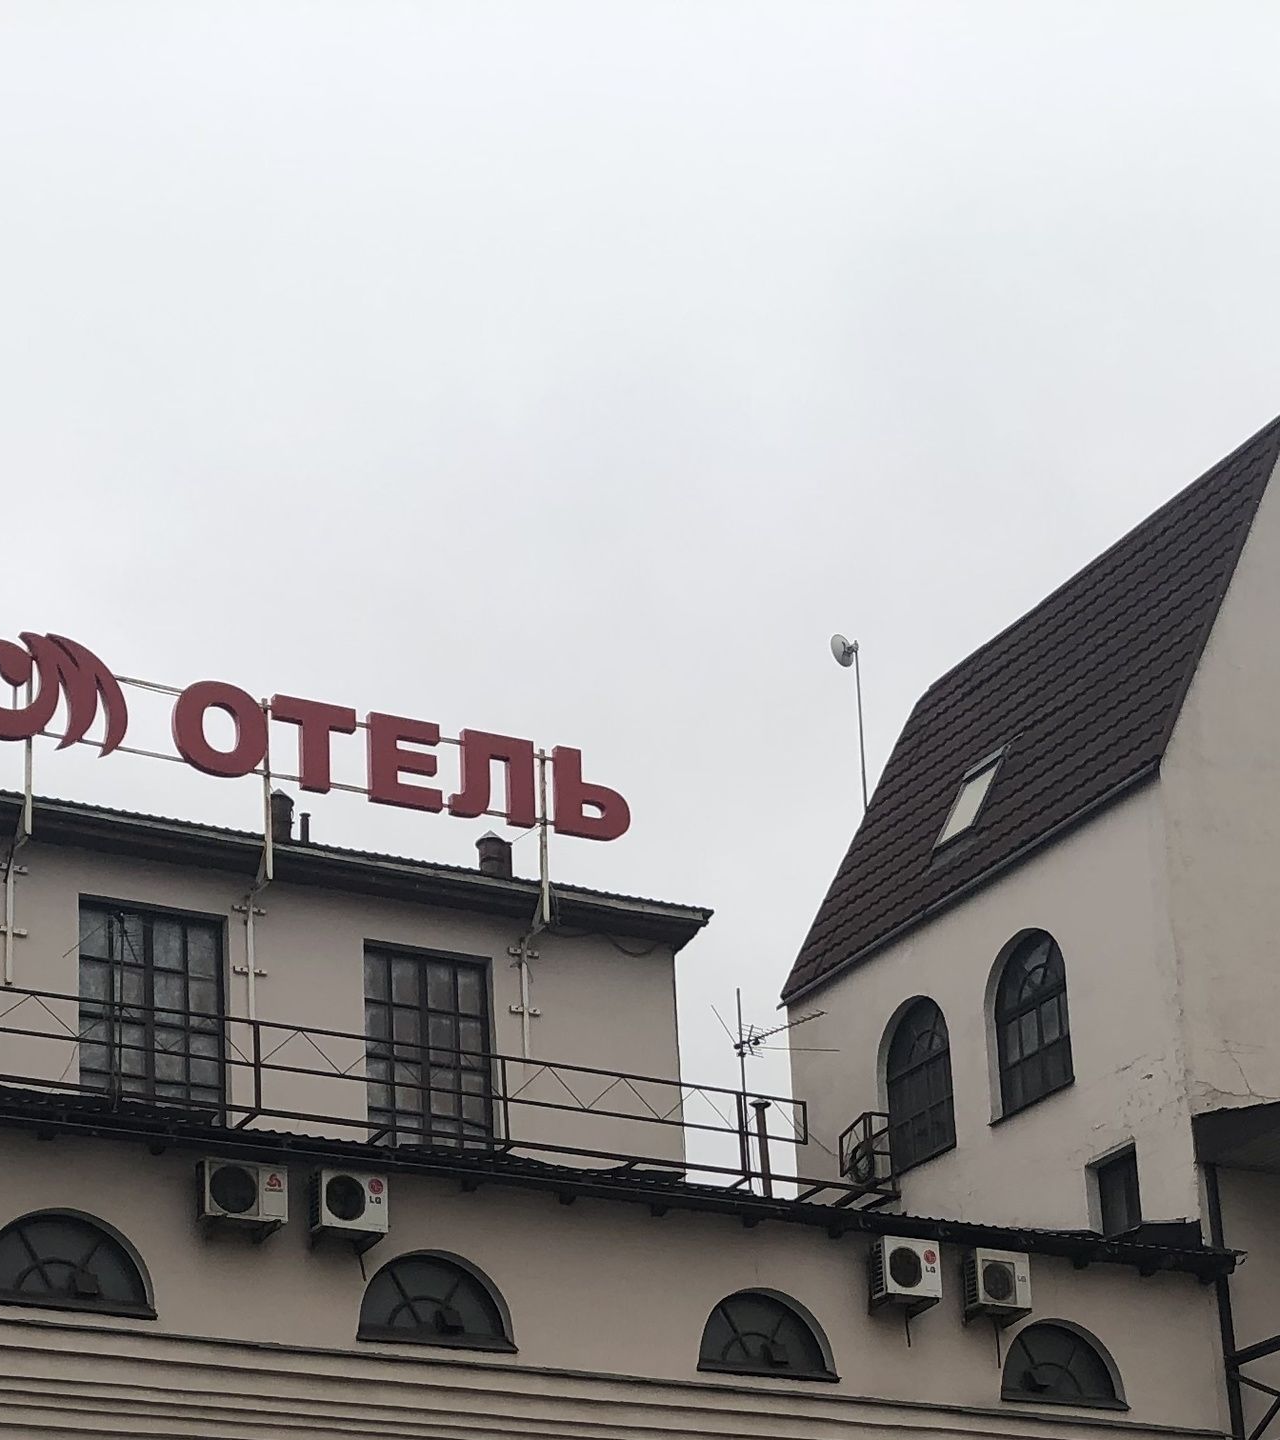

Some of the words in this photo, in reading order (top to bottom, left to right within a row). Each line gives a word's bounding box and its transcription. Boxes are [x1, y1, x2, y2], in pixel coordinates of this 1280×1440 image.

[172, 679, 631, 842] ОТЕЛЬ
[369, 1196, 382, 1204] LG
[926, 1265, 936, 1273] LG
